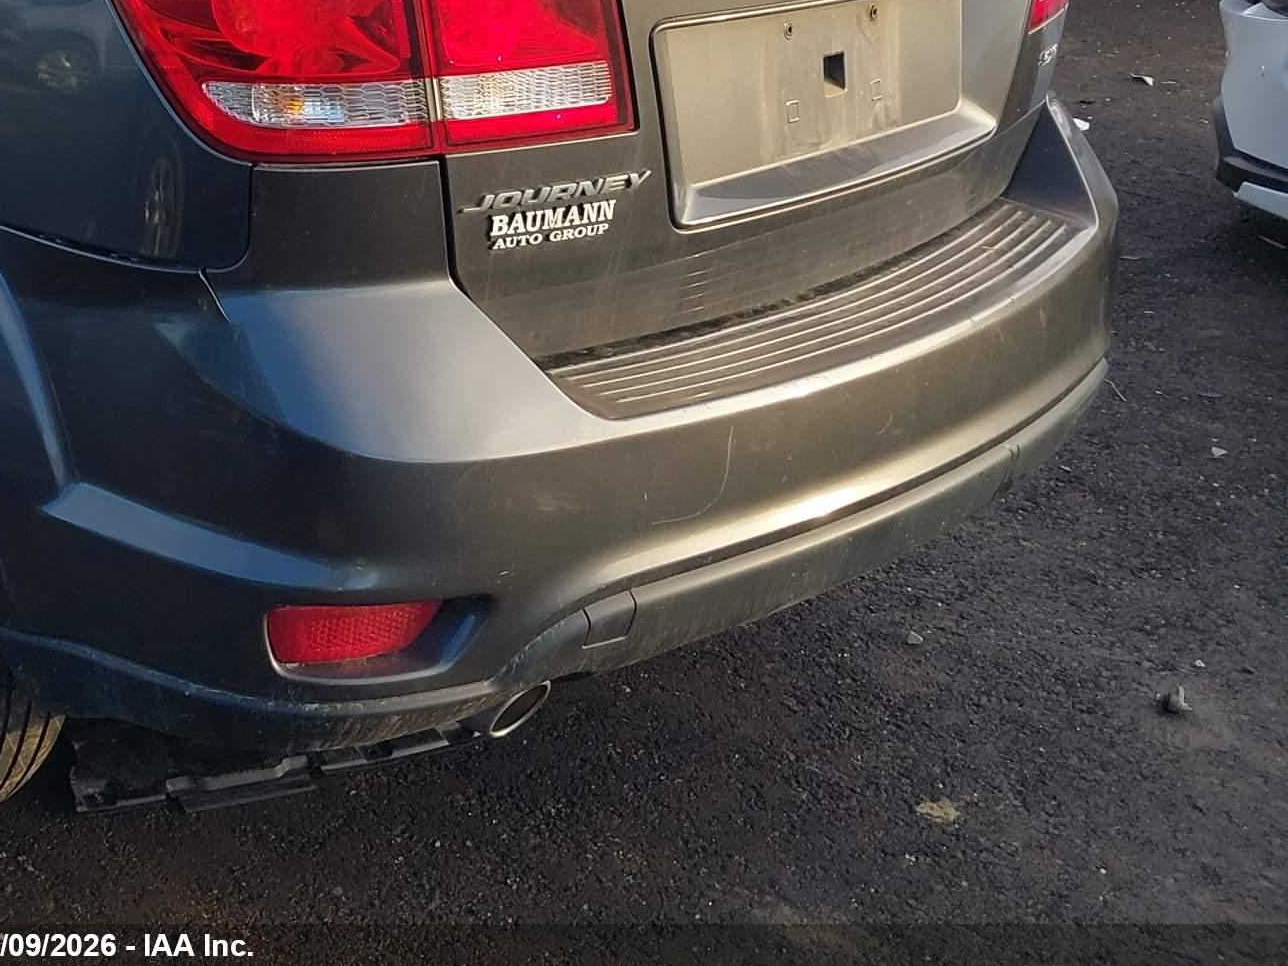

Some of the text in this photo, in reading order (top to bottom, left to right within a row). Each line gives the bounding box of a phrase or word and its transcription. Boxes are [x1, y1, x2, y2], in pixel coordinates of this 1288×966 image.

[458, 169, 653, 214] JOURNEY
[490, 199, 617, 237] BAUMANN
[492, 222, 610, 251] AUTO GROUP
